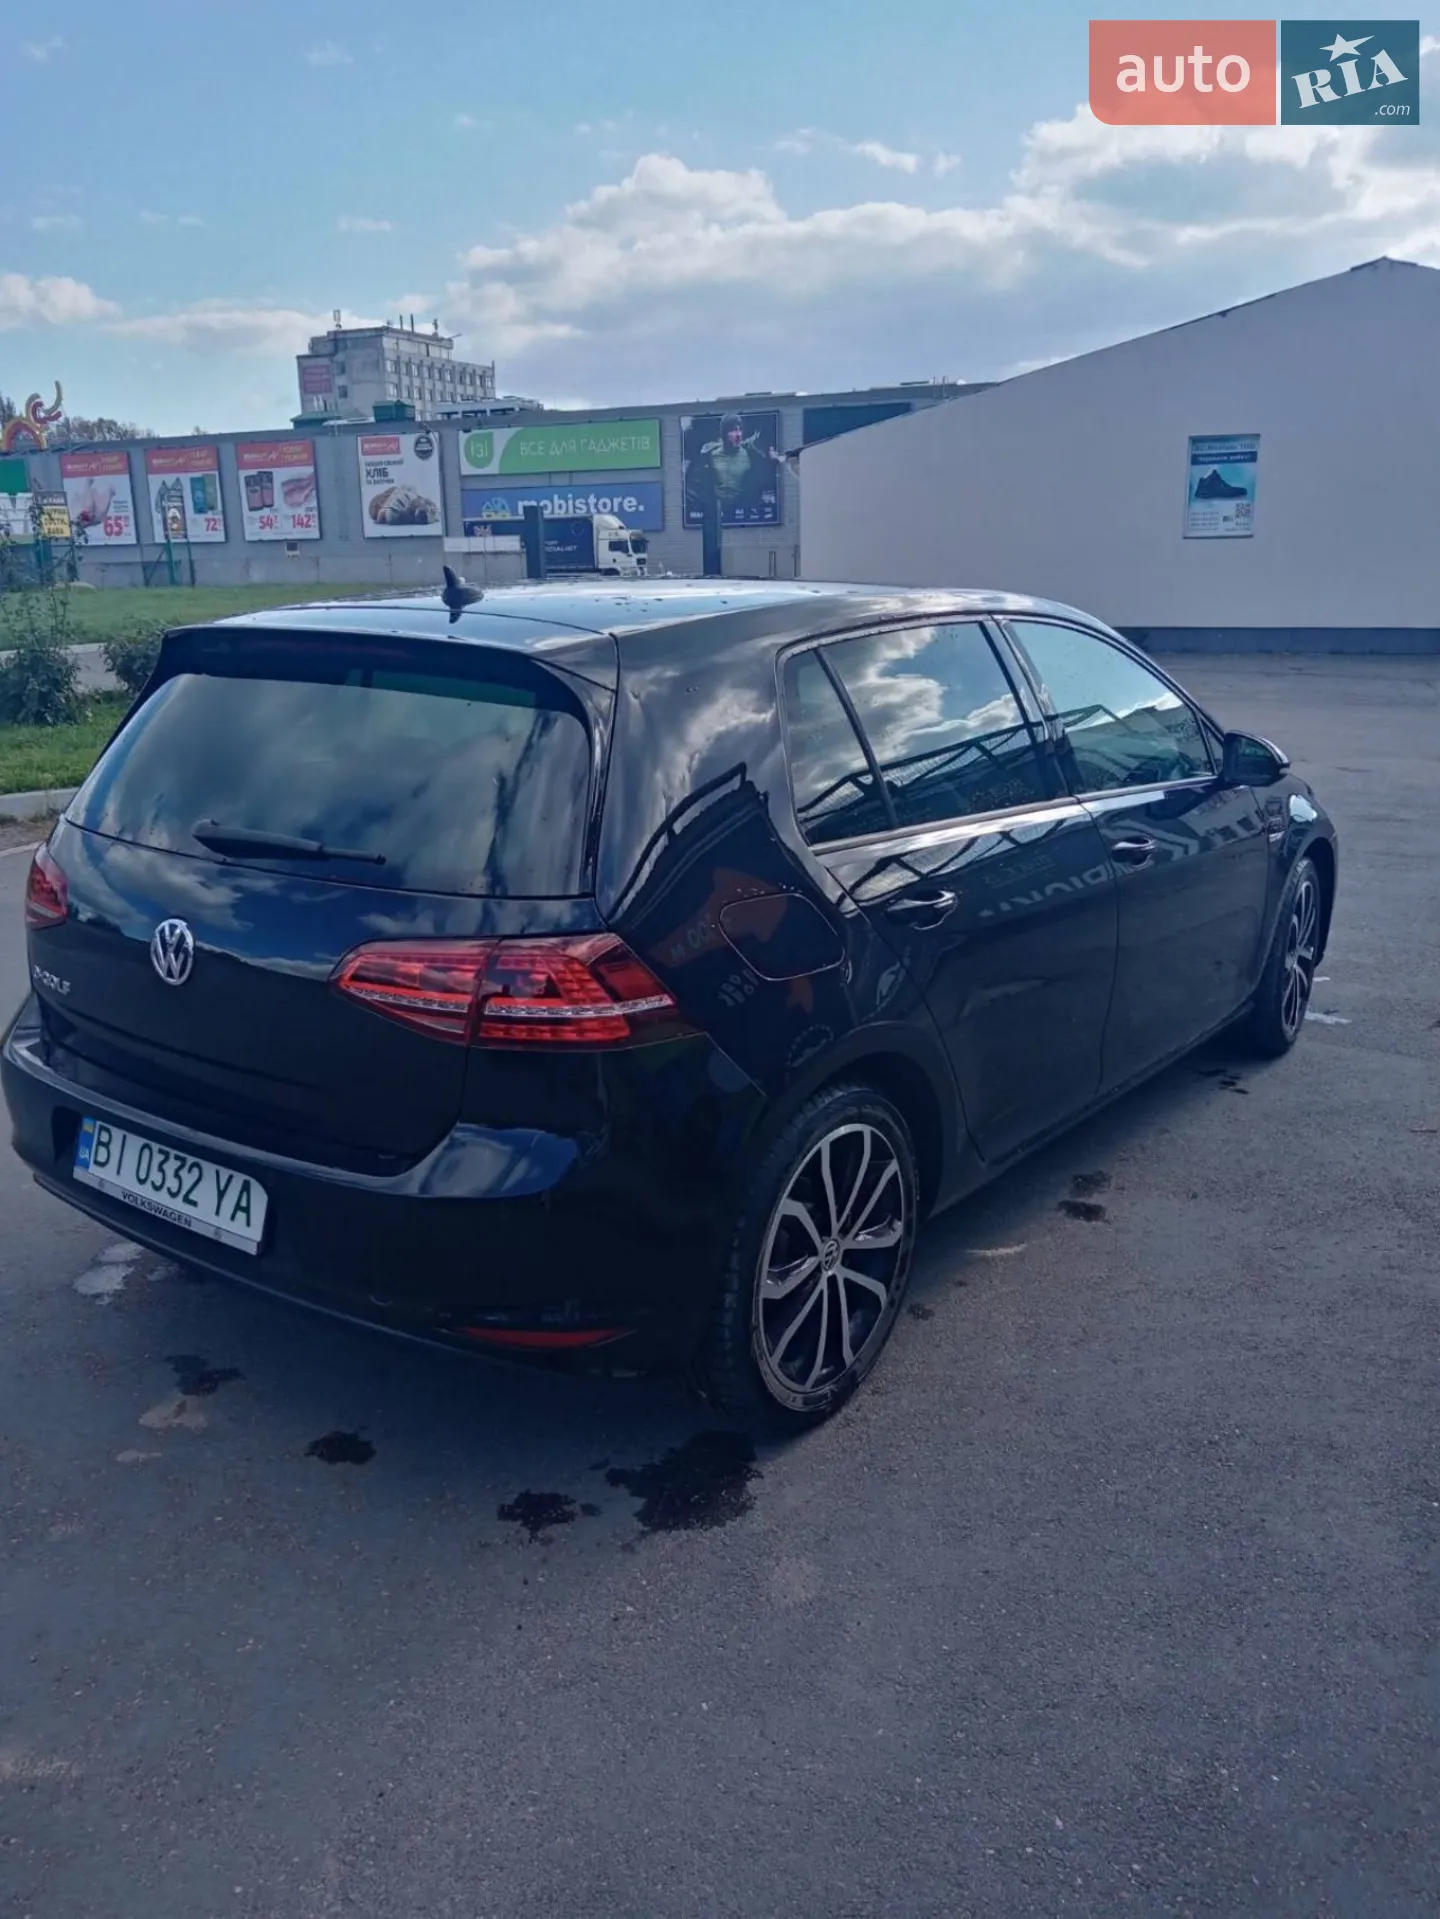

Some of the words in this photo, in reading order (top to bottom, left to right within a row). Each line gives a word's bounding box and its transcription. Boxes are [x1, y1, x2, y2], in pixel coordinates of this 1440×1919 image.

[520, 440, 545, 456] ВСЕ
[549, 438, 577, 456] ДЛЯ
[580, 435, 651, 453] ГАДЖЕТІВ
[365, 467, 389, 478] ХЛІБ
[103, 515, 124, 537] 65
[291, 514, 312, 529] 142
[79, 1149, 90, 1161] UA
[93, 1124, 127, 1177] BI
[135, 1142, 204, 1208] 0332
[215, 1168, 252, 1229] YA
[121, 1190, 192, 1228] VOLKSWAGEN
